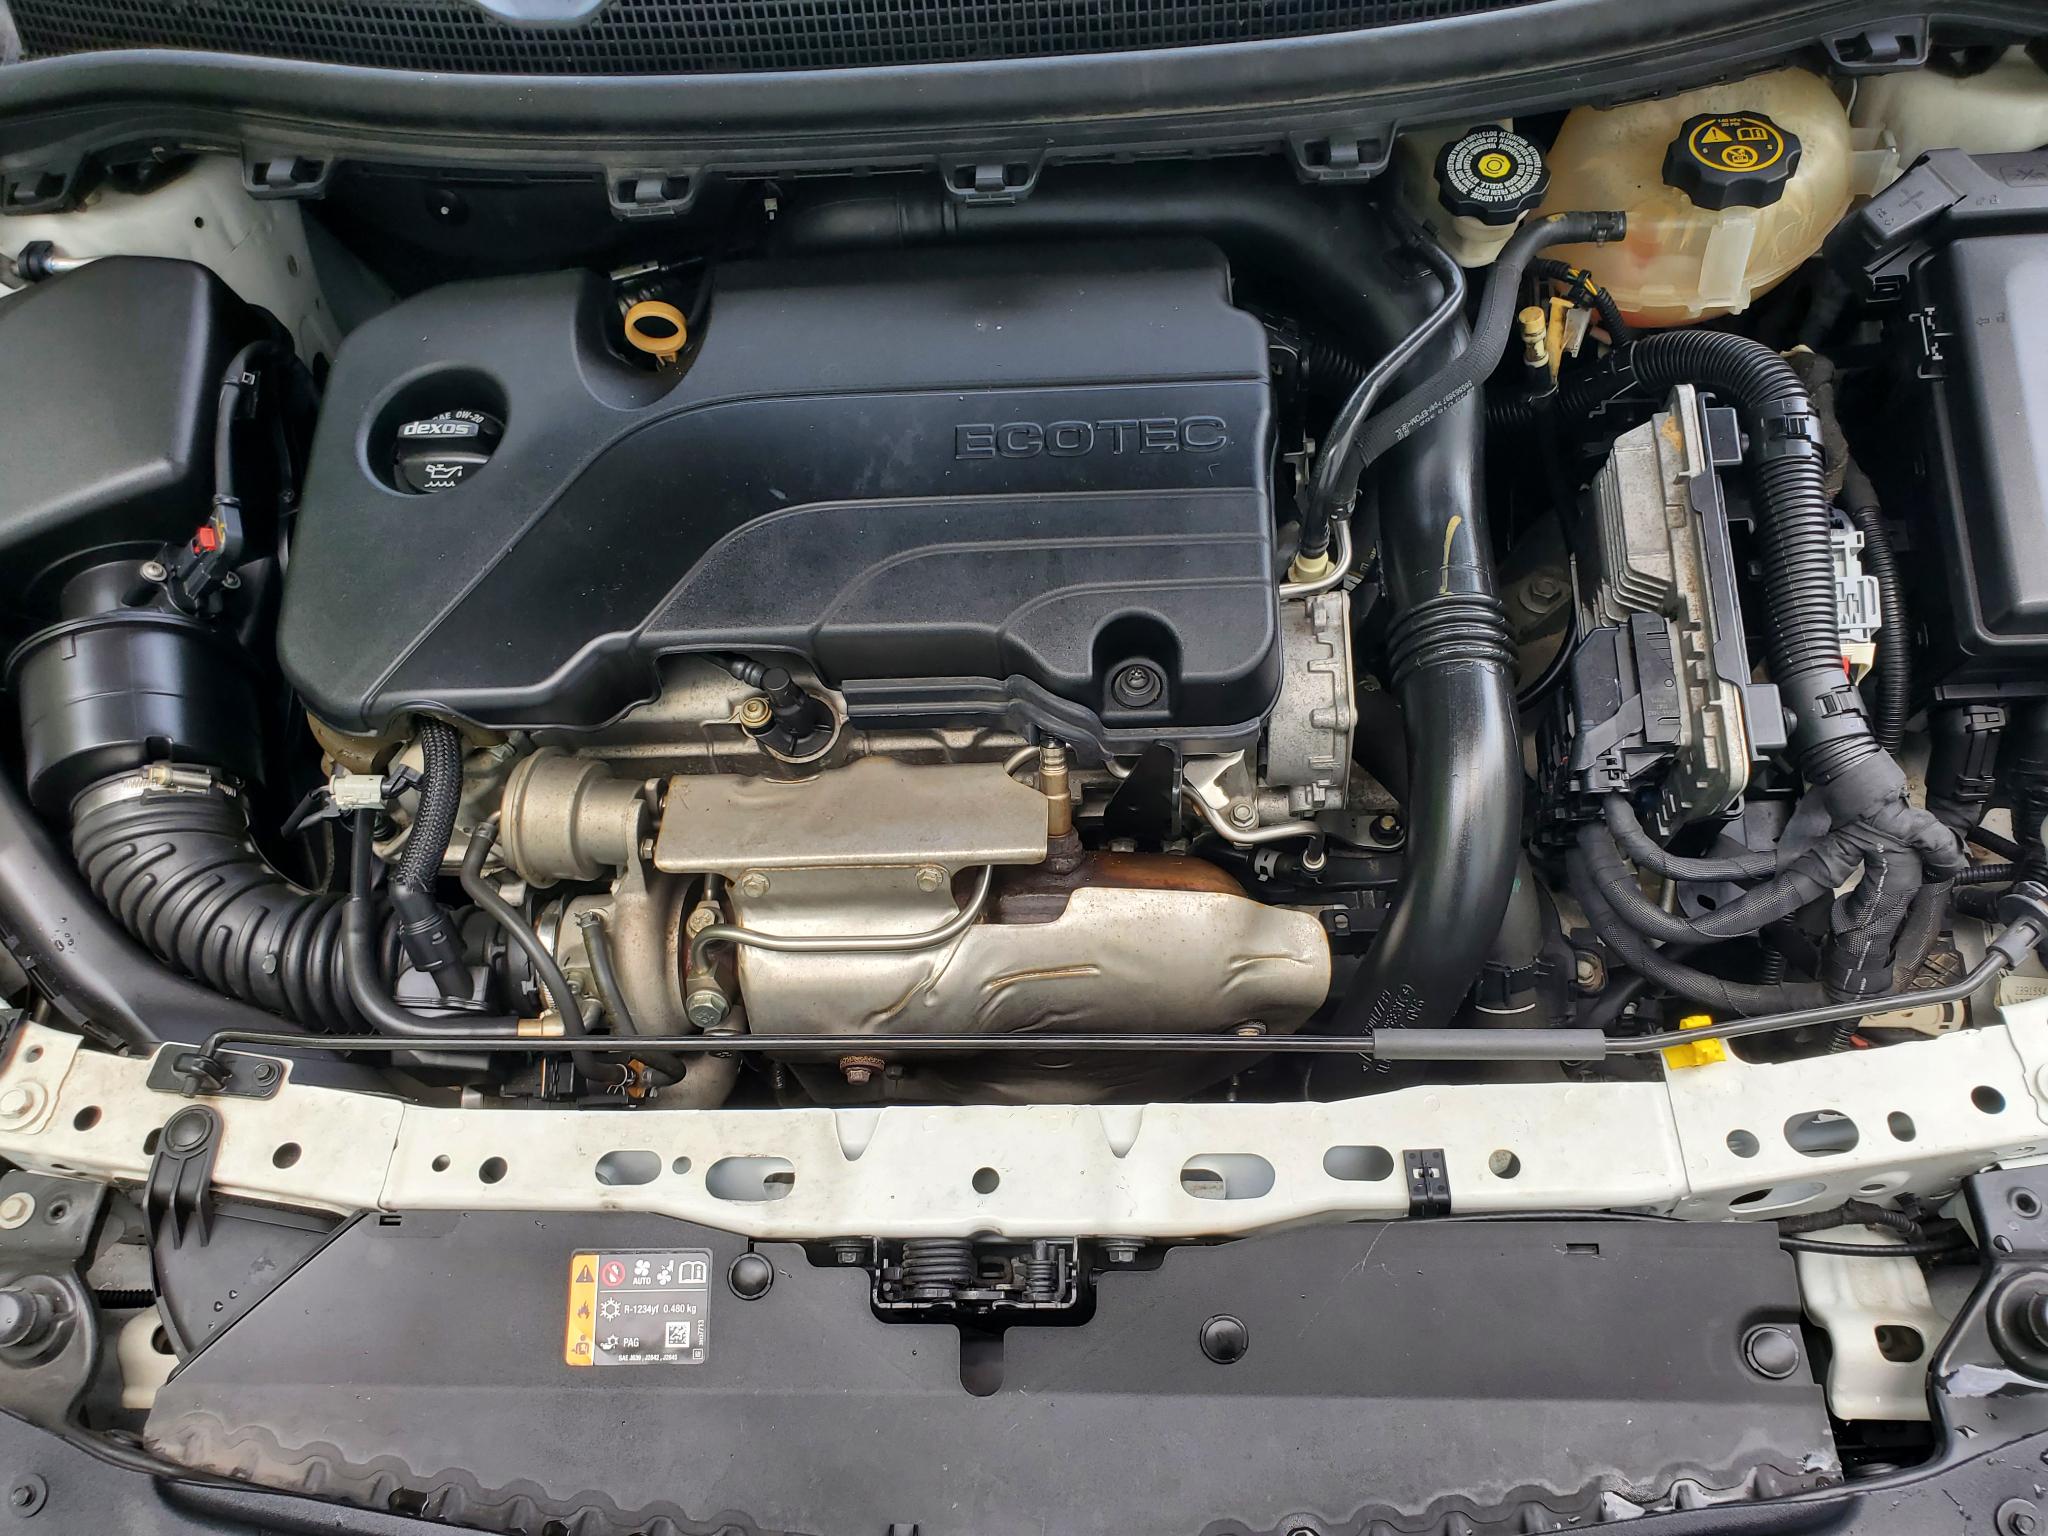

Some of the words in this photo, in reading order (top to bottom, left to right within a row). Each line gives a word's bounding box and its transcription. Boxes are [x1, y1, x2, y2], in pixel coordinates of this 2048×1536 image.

[1464, 131, 1482, 142] FLUID
[1465, 137, 1486, 150] BEFORE
[1461, 178, 1475, 189] ONLY
[1490, 187, 1508, 195] FREIN
[1502, 190, 1522, 200] AVANT
[455, 410, 485, 424] 0W-20
[404, 422, 469, 435] dexos
[955, 416, 1228, 460] ECOTEC
[633, 1276, 652, 1285] AUTO
[624, 1304, 659, 1316] R-1234yf
[663, 1304, 685, 1313] 0.480
[686, 1304, 697, 1314] kg
[623, 1337, 639, 1348] PAG
